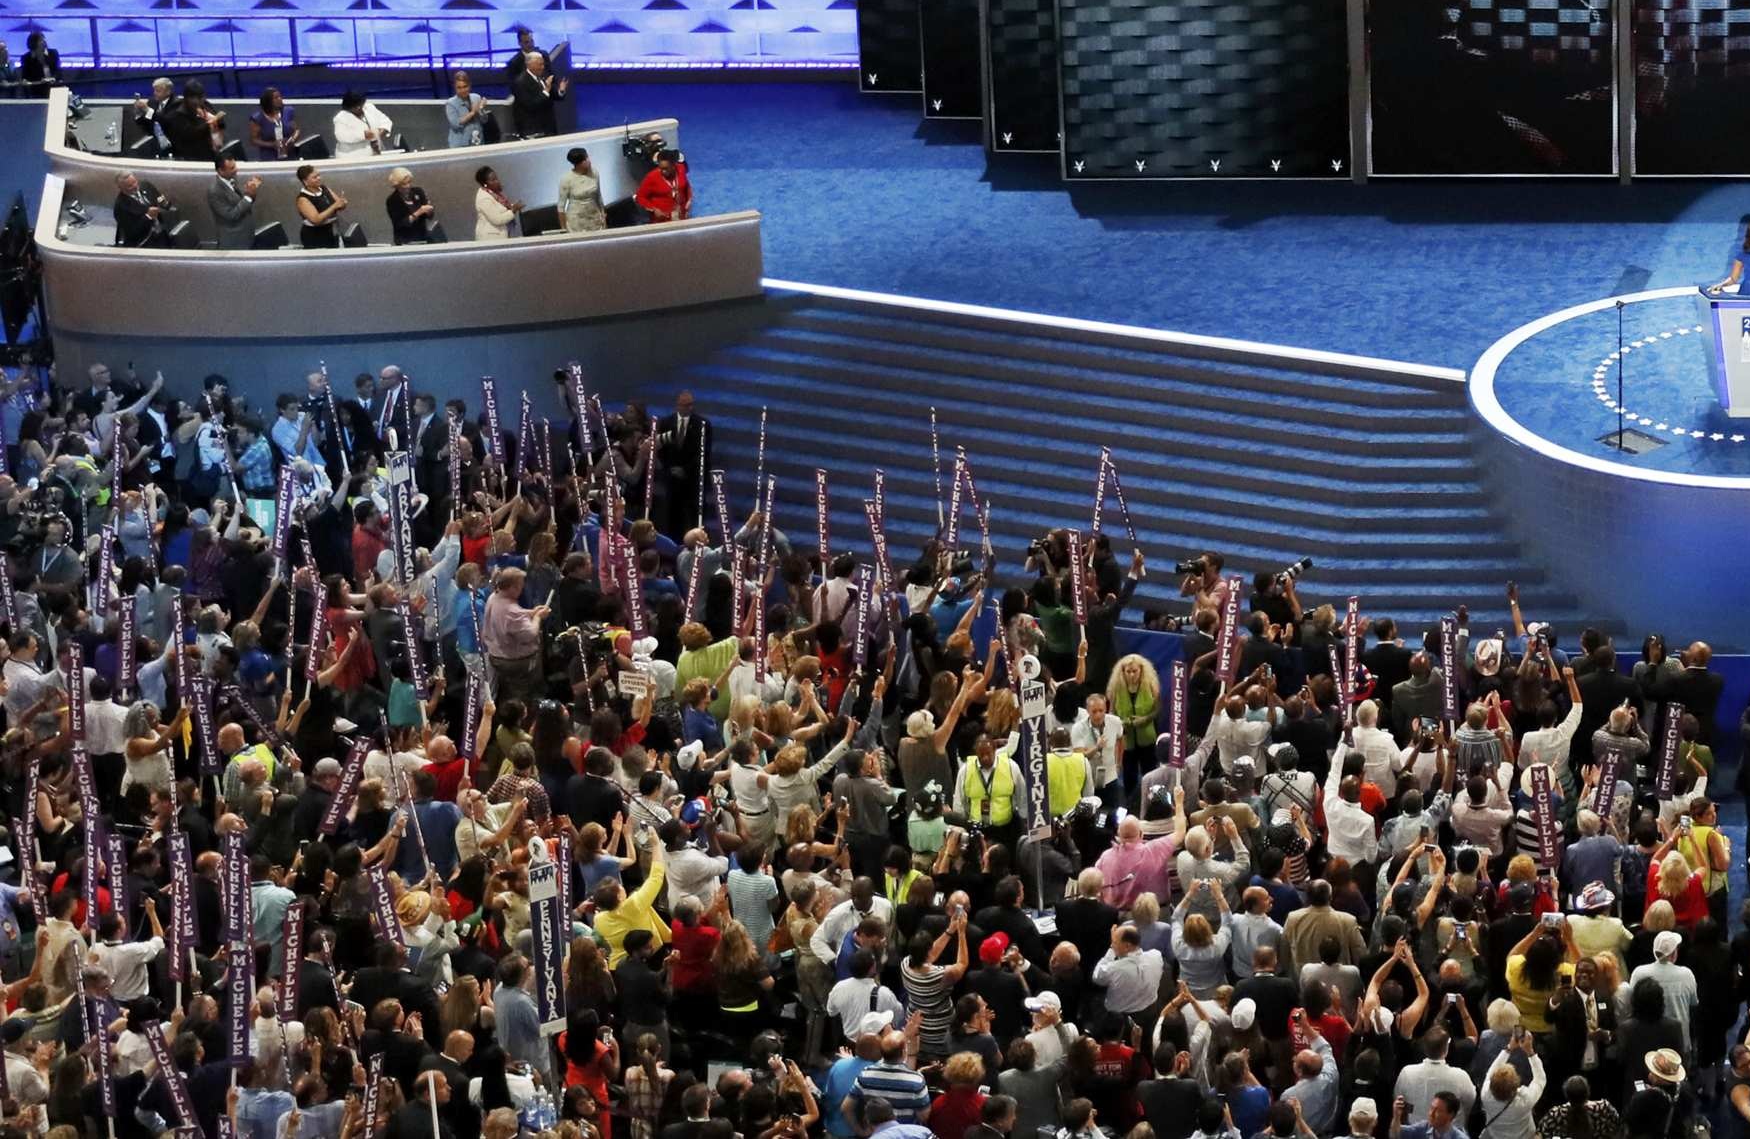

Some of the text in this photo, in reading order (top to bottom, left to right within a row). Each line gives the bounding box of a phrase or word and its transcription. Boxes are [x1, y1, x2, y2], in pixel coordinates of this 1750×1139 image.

[483, 381, 501, 455] MICHELLE
[572, 366, 591, 443] MICHELLE
[275, 469, 292, 548] MICHELLE
[605, 477, 615, 555] MICHELLE
[713, 473, 732, 553] MICHELLE
[816, 473, 827, 554] MICHELLE
[949, 460, 965, 542] MICHELLE
[1093, 450, 1108, 531] MICHELLE
[97, 531, 112, 609] MICHELLE
[398, 486, 413, 580] ARKANSAS
[1068, 534, 1083, 615] MICHELLE
[624, 546, 642, 630] MICHELLE
[684, 547, 704, 624] MICHELL
[734, 550, 744, 628] MICHELLE
[856, 569, 873, 654] MICHELLE
[1221, 580, 1240, 670] MICHELLE
[121, 600, 133, 679] MICHELLE
[308, 588, 327, 670] MICHELLE
[401, 605, 423, 690] MICHELLE
[1347, 602, 1357, 693] MICHELLE
[1443, 622, 1454, 709] MICHELLE
[70, 648, 82, 731] MICHELLE
[192, 681, 216, 766] MICHELLE
[465, 678, 479, 751] MICHELLE
[1171, 666, 1184, 758] MICHELLE
[325, 741, 368, 824] MICHELLE
[1028, 717, 1046, 826] VIRGINIA
[1661, 707, 1682, 791] MICHELLE
[1533, 771, 1554, 858] MICHELLE
[229, 836, 240, 929] MICHELLE
[285, 910, 300, 1011] MICHELLE
[539, 900, 558, 1020] PENNSYLVANIA
[232, 954, 246, 1055] MICHELLE
[96, 1002, 111, 1105] MICHELLE
[365, 1059, 381, 1138] MICHEL
